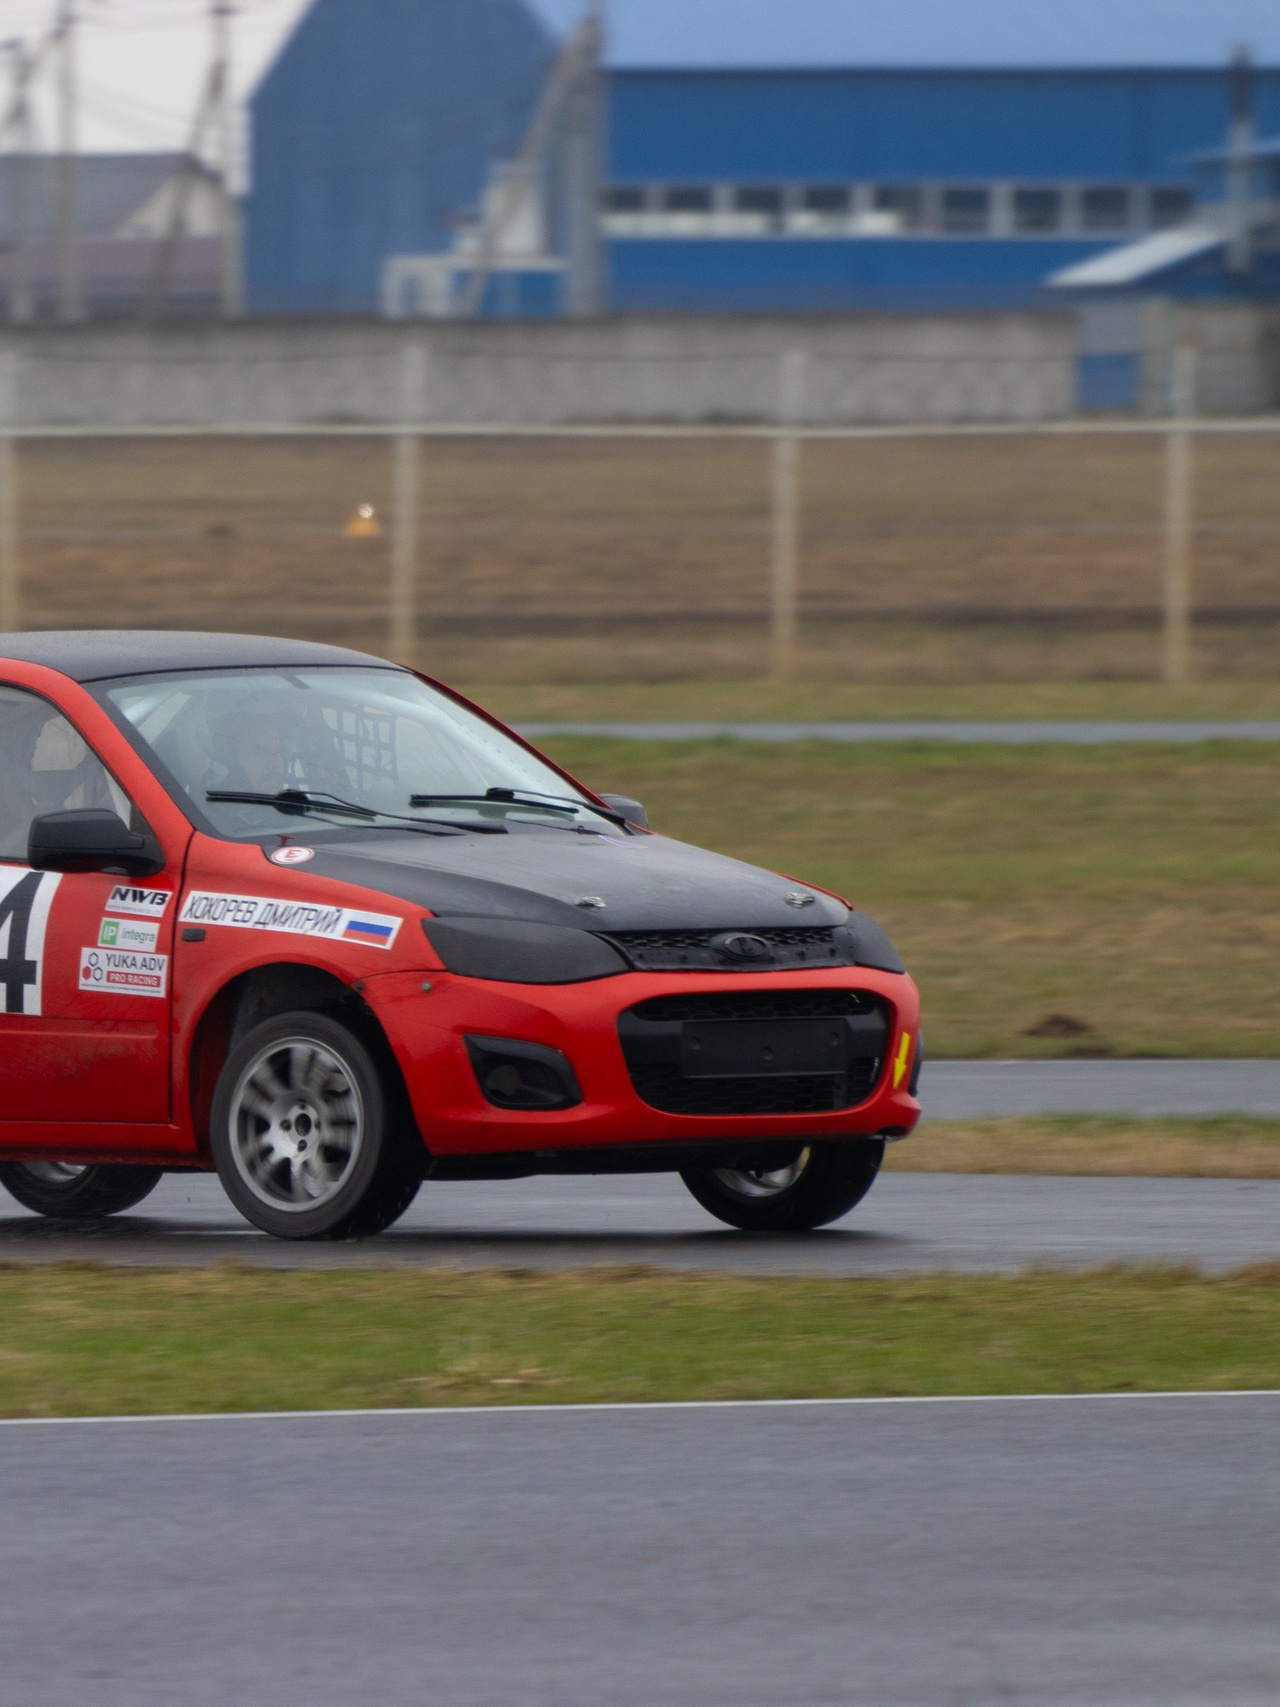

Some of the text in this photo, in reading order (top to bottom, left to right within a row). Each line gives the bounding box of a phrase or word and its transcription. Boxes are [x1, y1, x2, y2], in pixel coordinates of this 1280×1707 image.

[110, 887, 168, 905] NWB
[252, 903, 343, 934] ДМИТРИЙ
[103, 925, 155, 944] IP integra
[106, 953, 165, 972] YUKA ADV
[109, 972, 158, 986] PRO RACING
